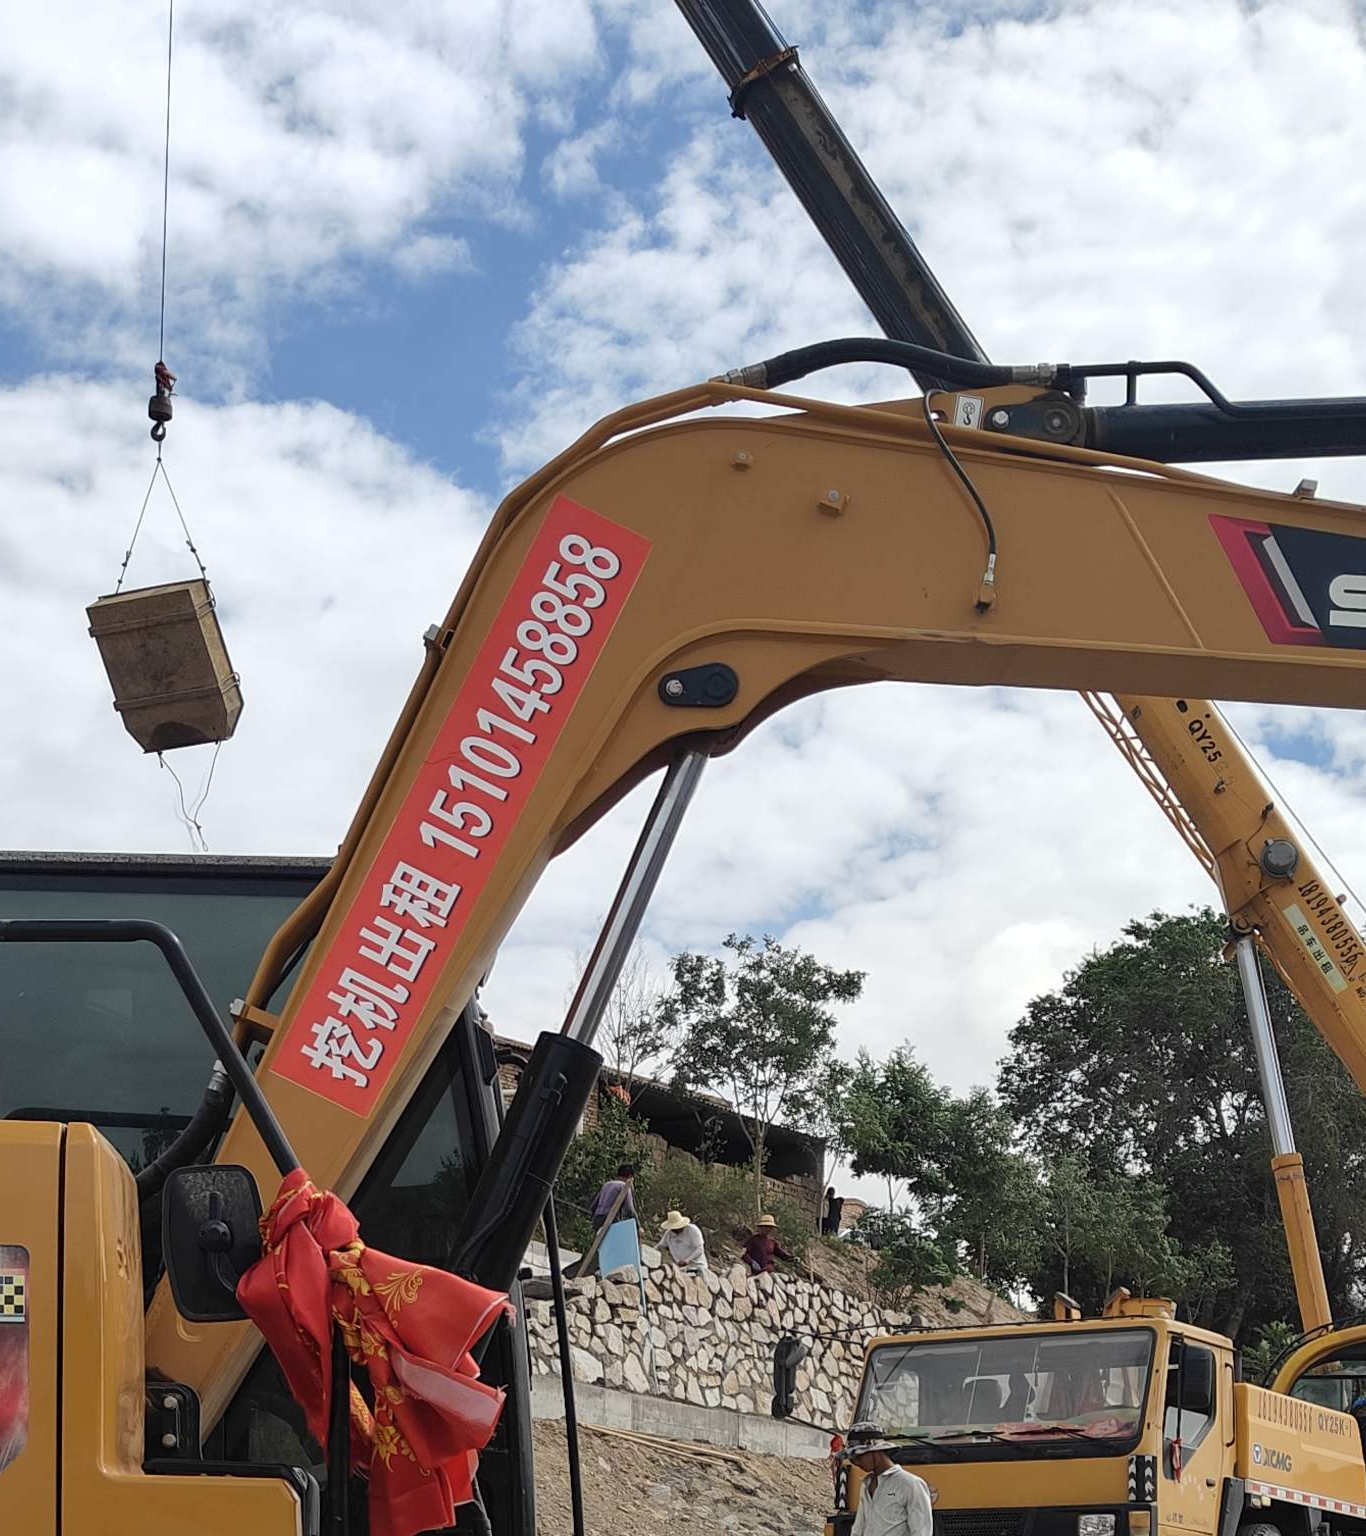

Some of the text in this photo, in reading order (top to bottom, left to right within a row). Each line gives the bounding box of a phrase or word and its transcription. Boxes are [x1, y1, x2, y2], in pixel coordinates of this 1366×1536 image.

[301, 532, 621, 1089] 挖机出租 15101458858
[1297, 924, 1333, 975] 吊车出租
[1298, 880, 1363, 966] 18194380556
